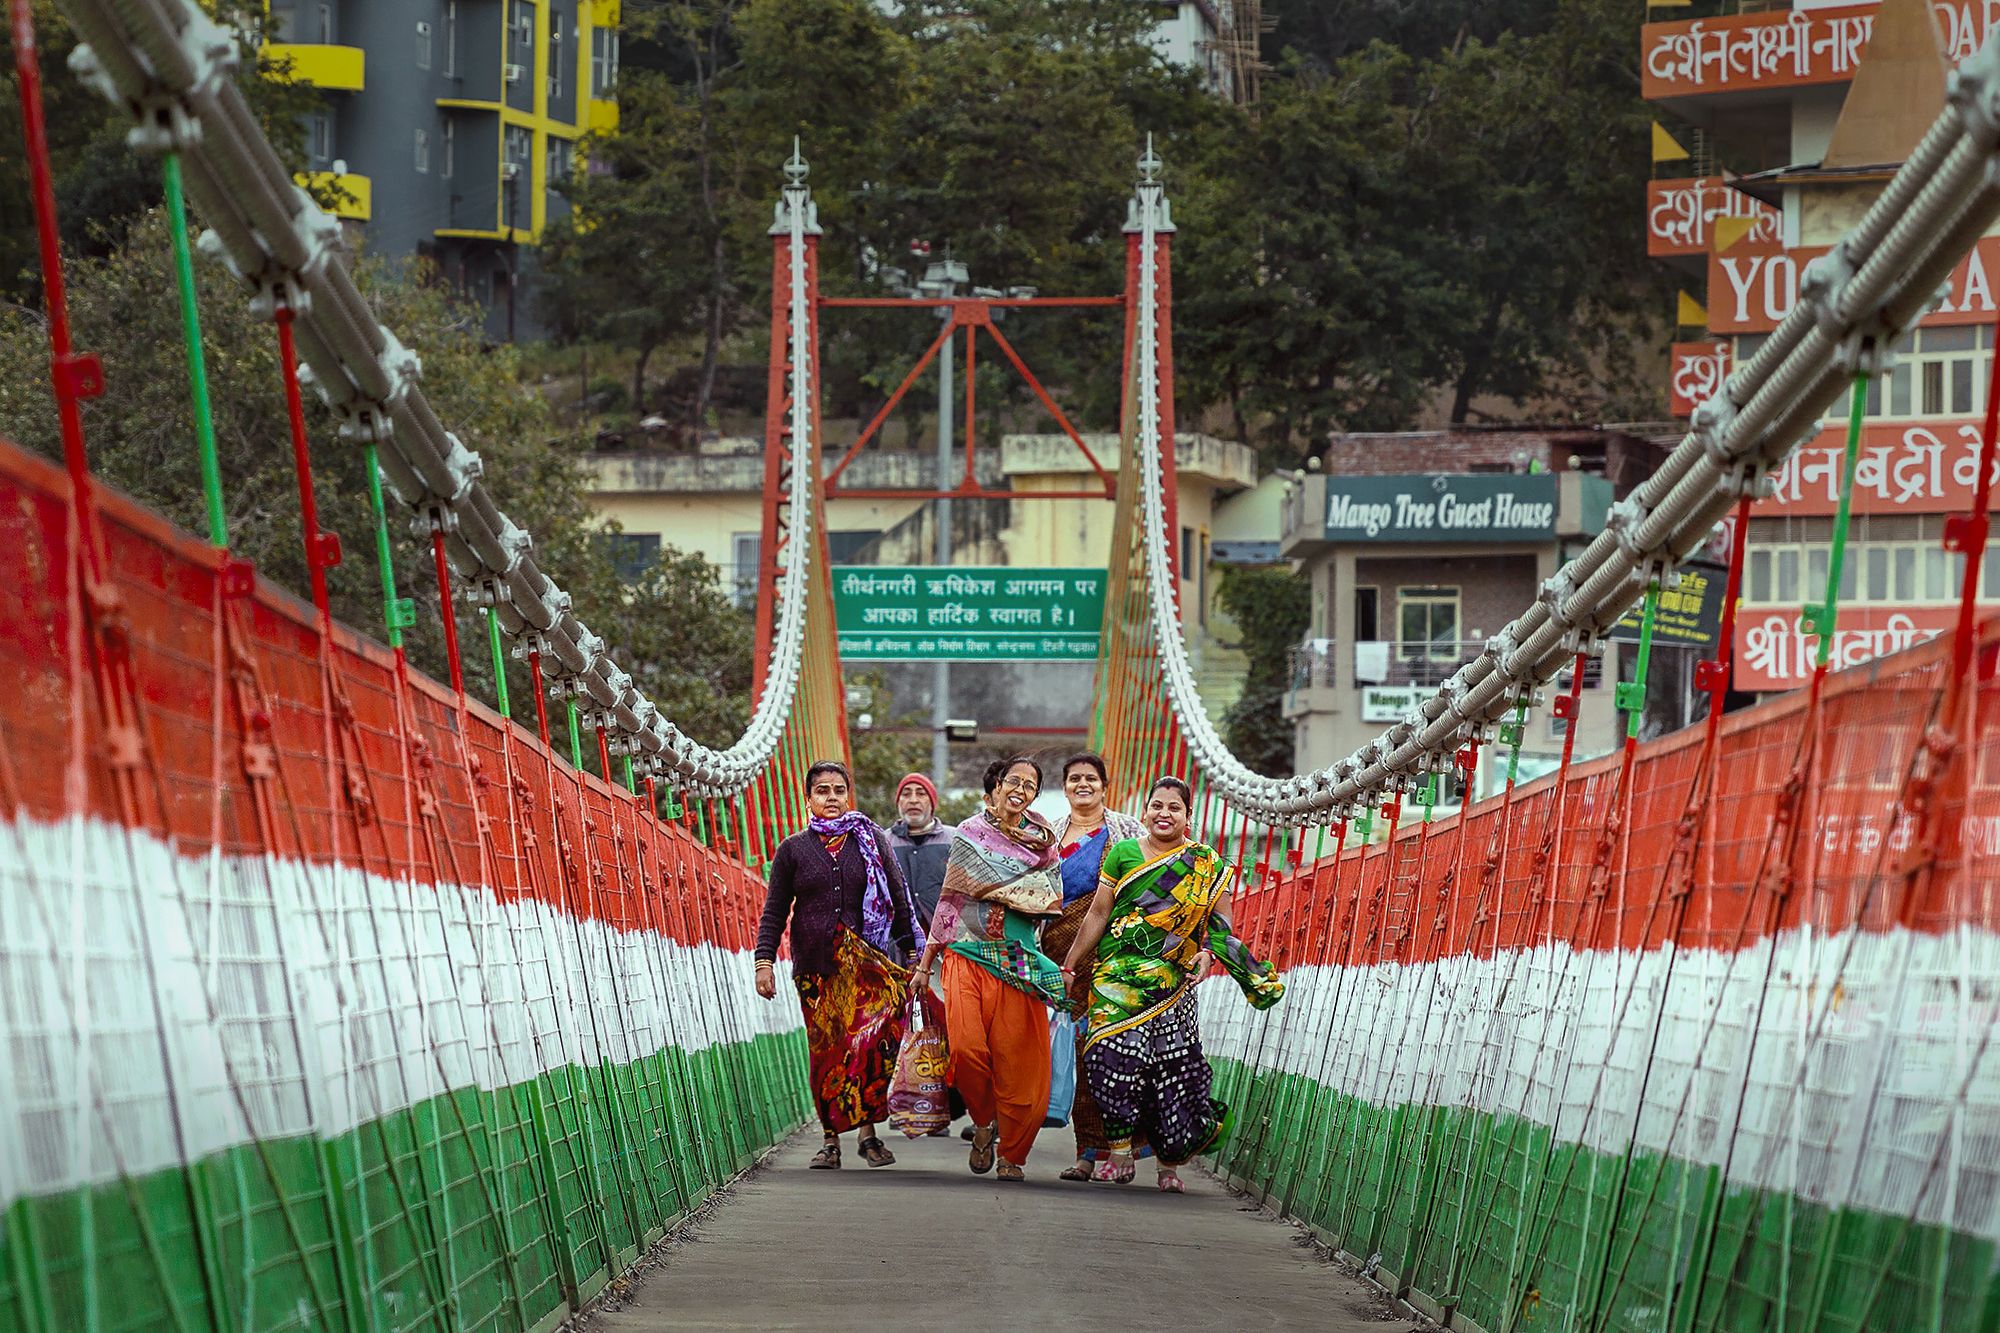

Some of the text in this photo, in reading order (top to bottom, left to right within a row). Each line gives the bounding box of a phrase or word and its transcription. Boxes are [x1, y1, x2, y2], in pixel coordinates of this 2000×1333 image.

[1648, 20, 1730, 84] दर्शन
[1729, 10, 1813, 80] लक्ष्मी
[1719, 255, 1800, 322] YO
[1855, 427, 1946, 504] बद्री
[1327, 493, 1554, 536] Mango Tree Guest House
[841, 573, 1097, 596] तीर्थनगरी ऋषिकेश आगमन पर
[1680, 571, 1709, 589] afe
[862, 608, 918, 624] आपका
[927, 602, 980, 626] हार्दिक
[989, 607, 1042, 624] स्वागत
[1743, 616, 1790, 679] श्री
